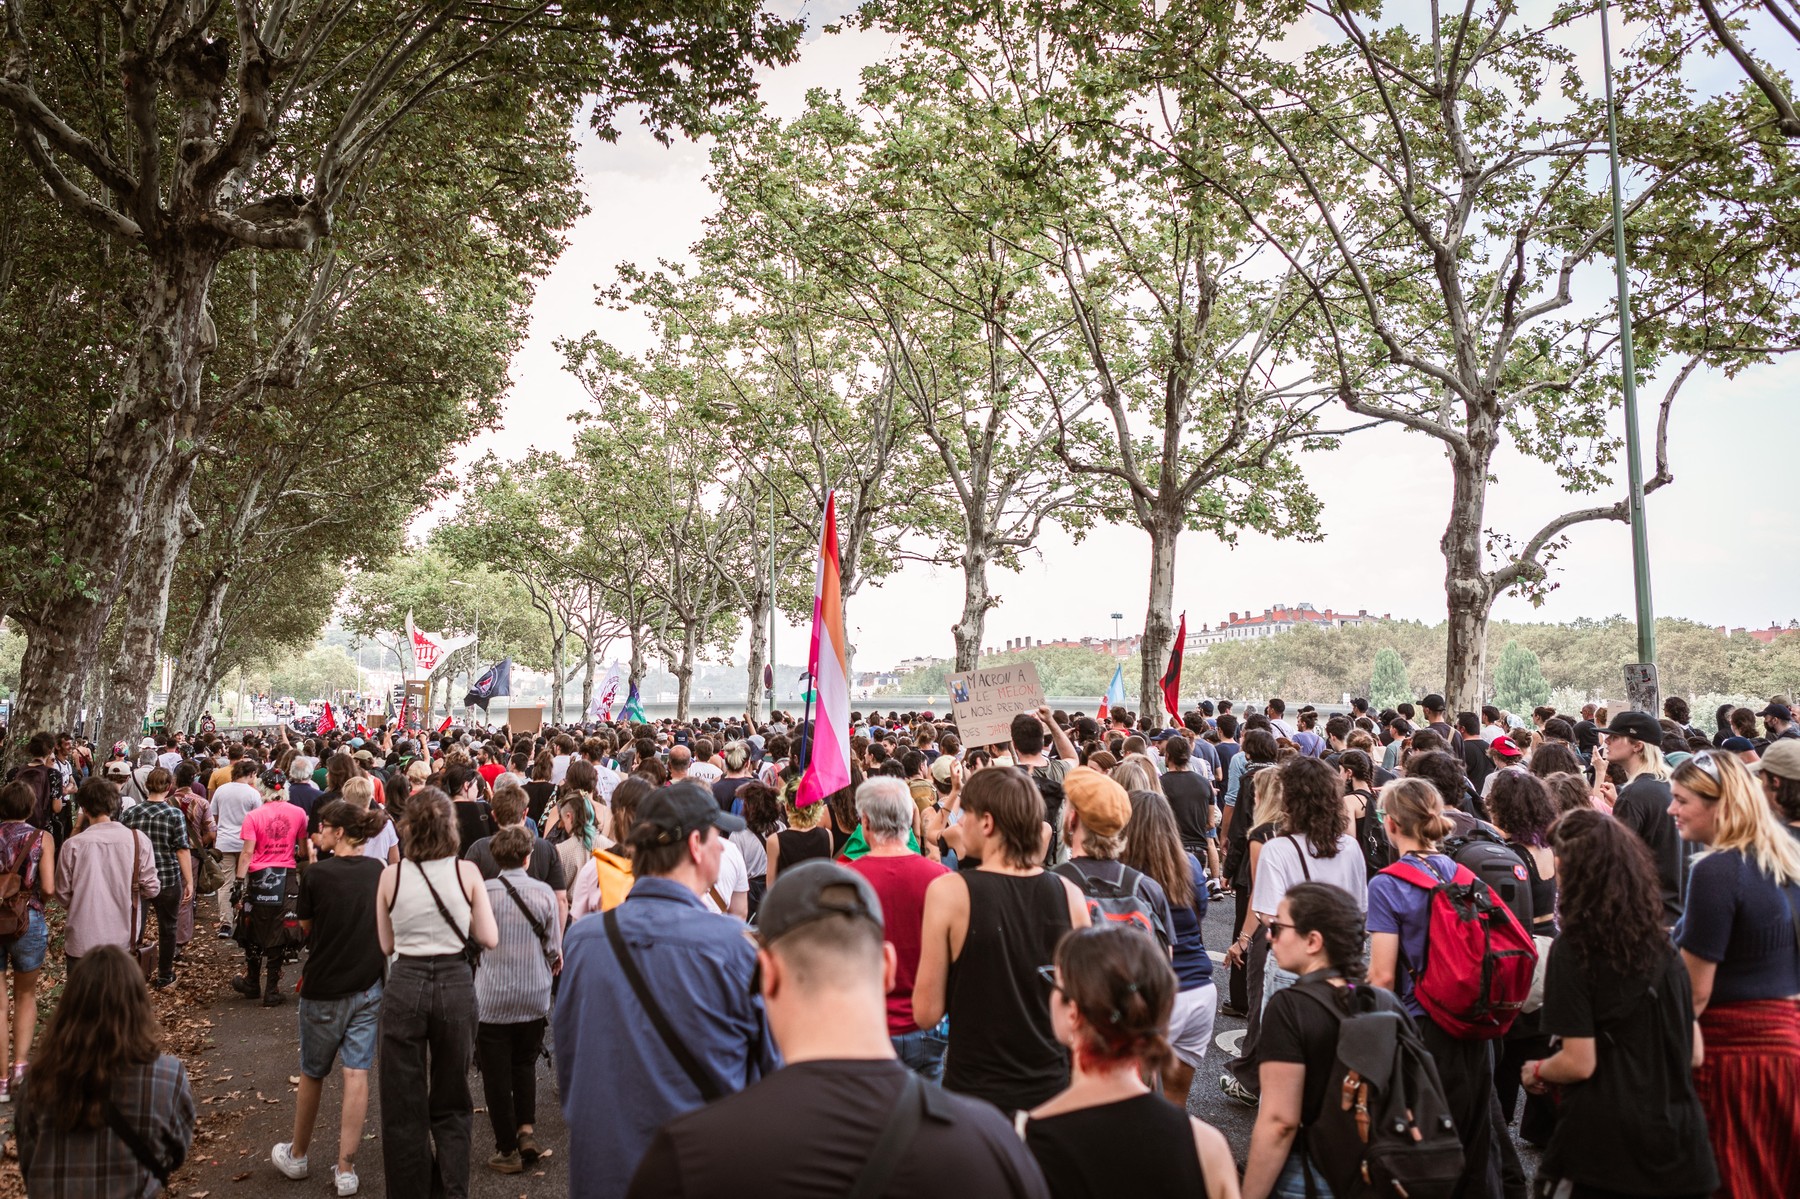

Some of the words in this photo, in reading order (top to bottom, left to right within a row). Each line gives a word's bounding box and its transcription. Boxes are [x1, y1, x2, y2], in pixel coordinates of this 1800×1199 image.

[966, 672, 1010, 689] MACRON
[1018, 669, 1026, 682] A
[976, 691, 990, 702] LE
[997, 684, 1036, 699] MELON,
[956, 709, 967, 720] IL
[971, 705, 993, 718] NOUS
[997, 702, 1024, 712] PREND
[962, 727, 980, 737] DES
[987, 723, 1010, 736] JAMB
